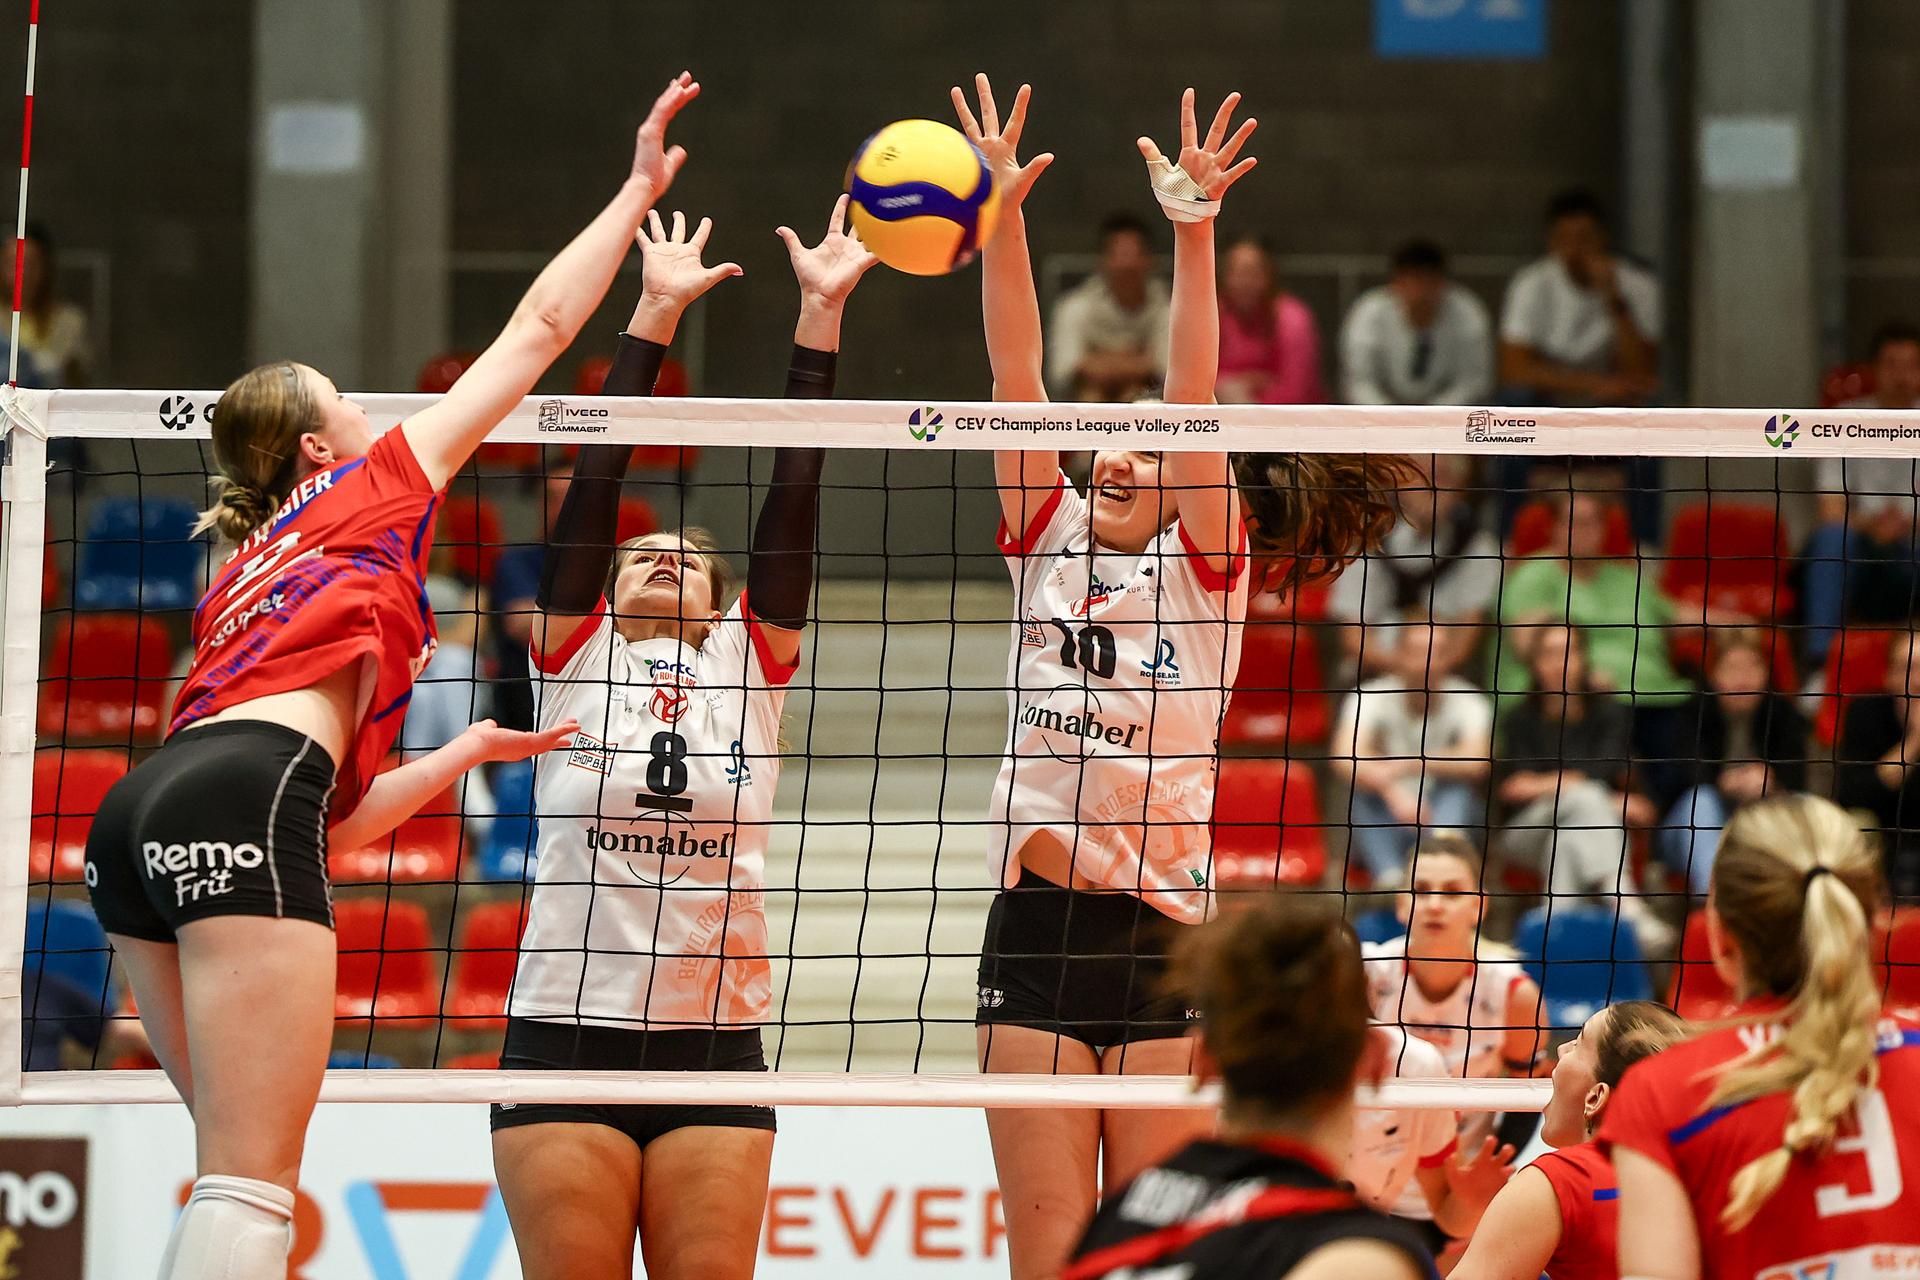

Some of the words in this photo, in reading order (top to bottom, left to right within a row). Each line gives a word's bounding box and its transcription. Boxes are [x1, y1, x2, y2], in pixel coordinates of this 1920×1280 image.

[565, 408, 609, 417] IVECO
[547, 425, 609, 433] CAMMAERT
[954, 417, 986, 431] CEV
[989, 417, 1073, 434] Champions
[1076, 418, 1131, 435] League
[1134, 418, 1181, 436] Volley
[1184, 419, 1220, 433] 2025
[1493, 419, 1537, 427] IVECO
[1811, 424, 1843, 438] CEV
[1474, 435, 1537, 443] CAMMAERT
[1051, 617, 1117, 680] 10
[646, 731, 688, 796] 8
[586, 825, 731, 859] tomabel
[142, 841, 265, 880] Remo
[174, 869, 235, 907] Frit
